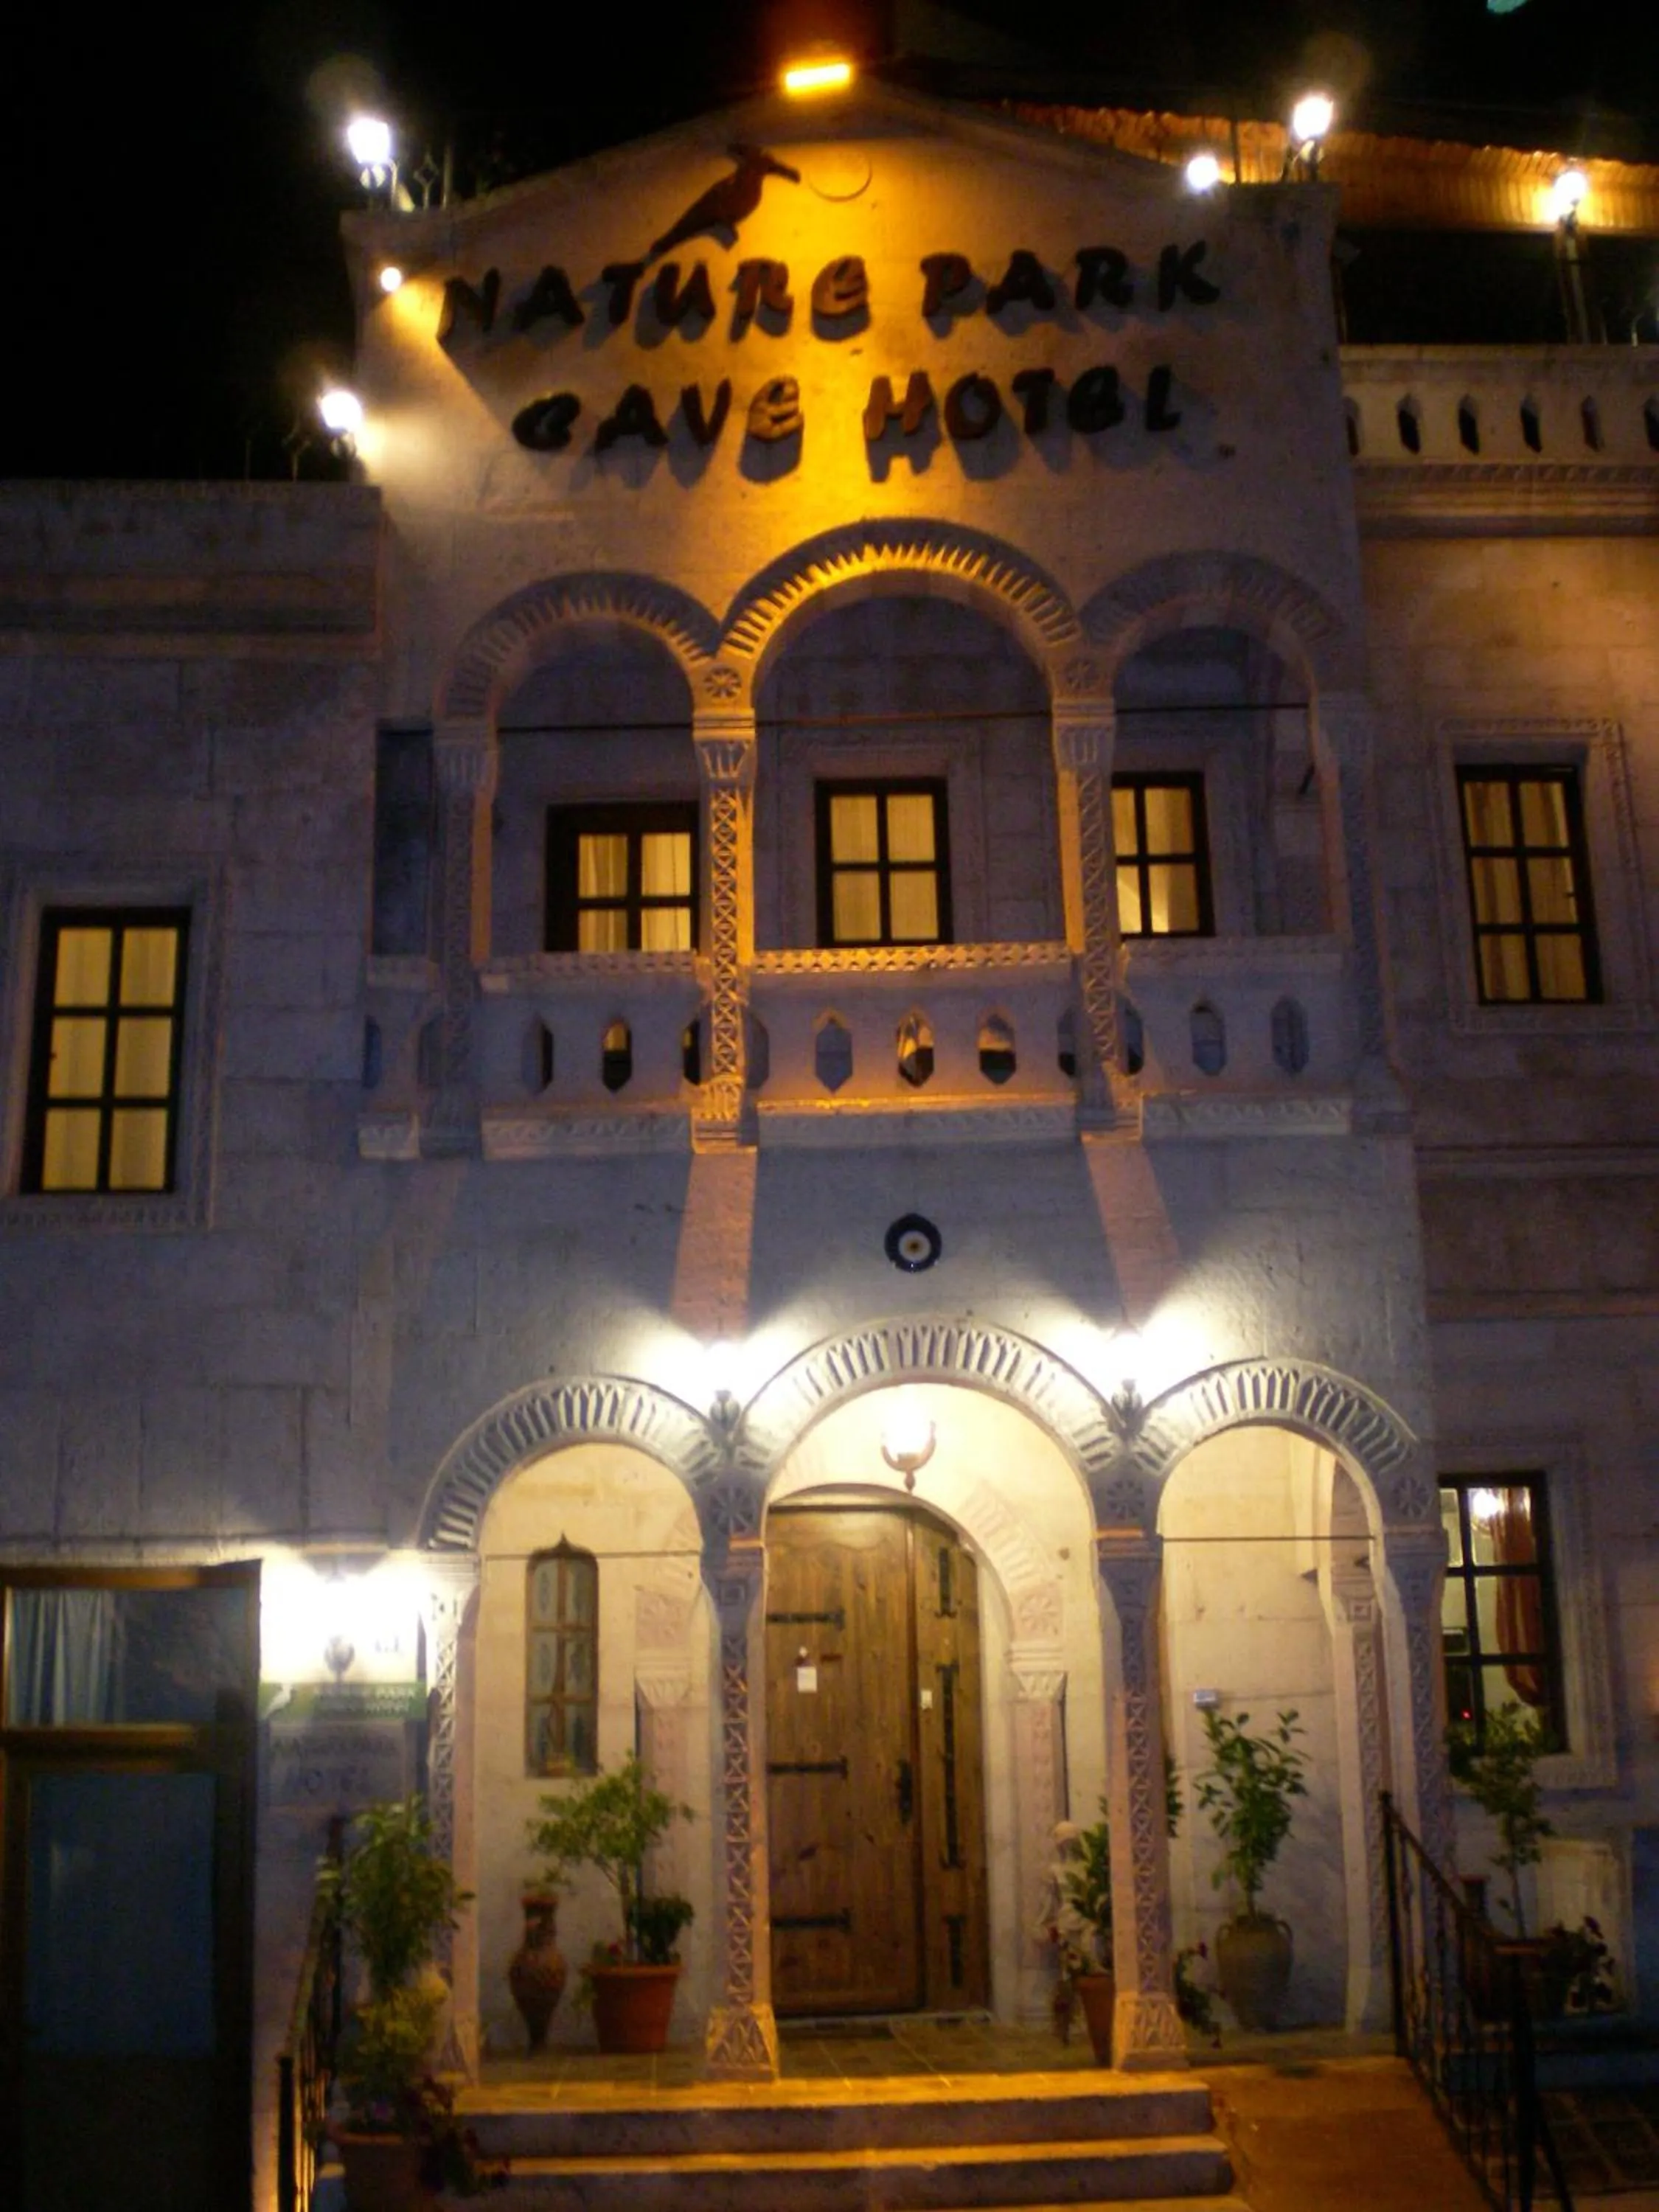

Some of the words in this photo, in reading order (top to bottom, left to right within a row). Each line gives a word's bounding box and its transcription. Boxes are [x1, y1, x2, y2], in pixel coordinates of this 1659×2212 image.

[441, 255, 869, 336] NATURE
[919, 240, 1221, 319] PARK
[512, 376, 800, 451] CAVE
[863, 365, 1182, 441] HOTEL
